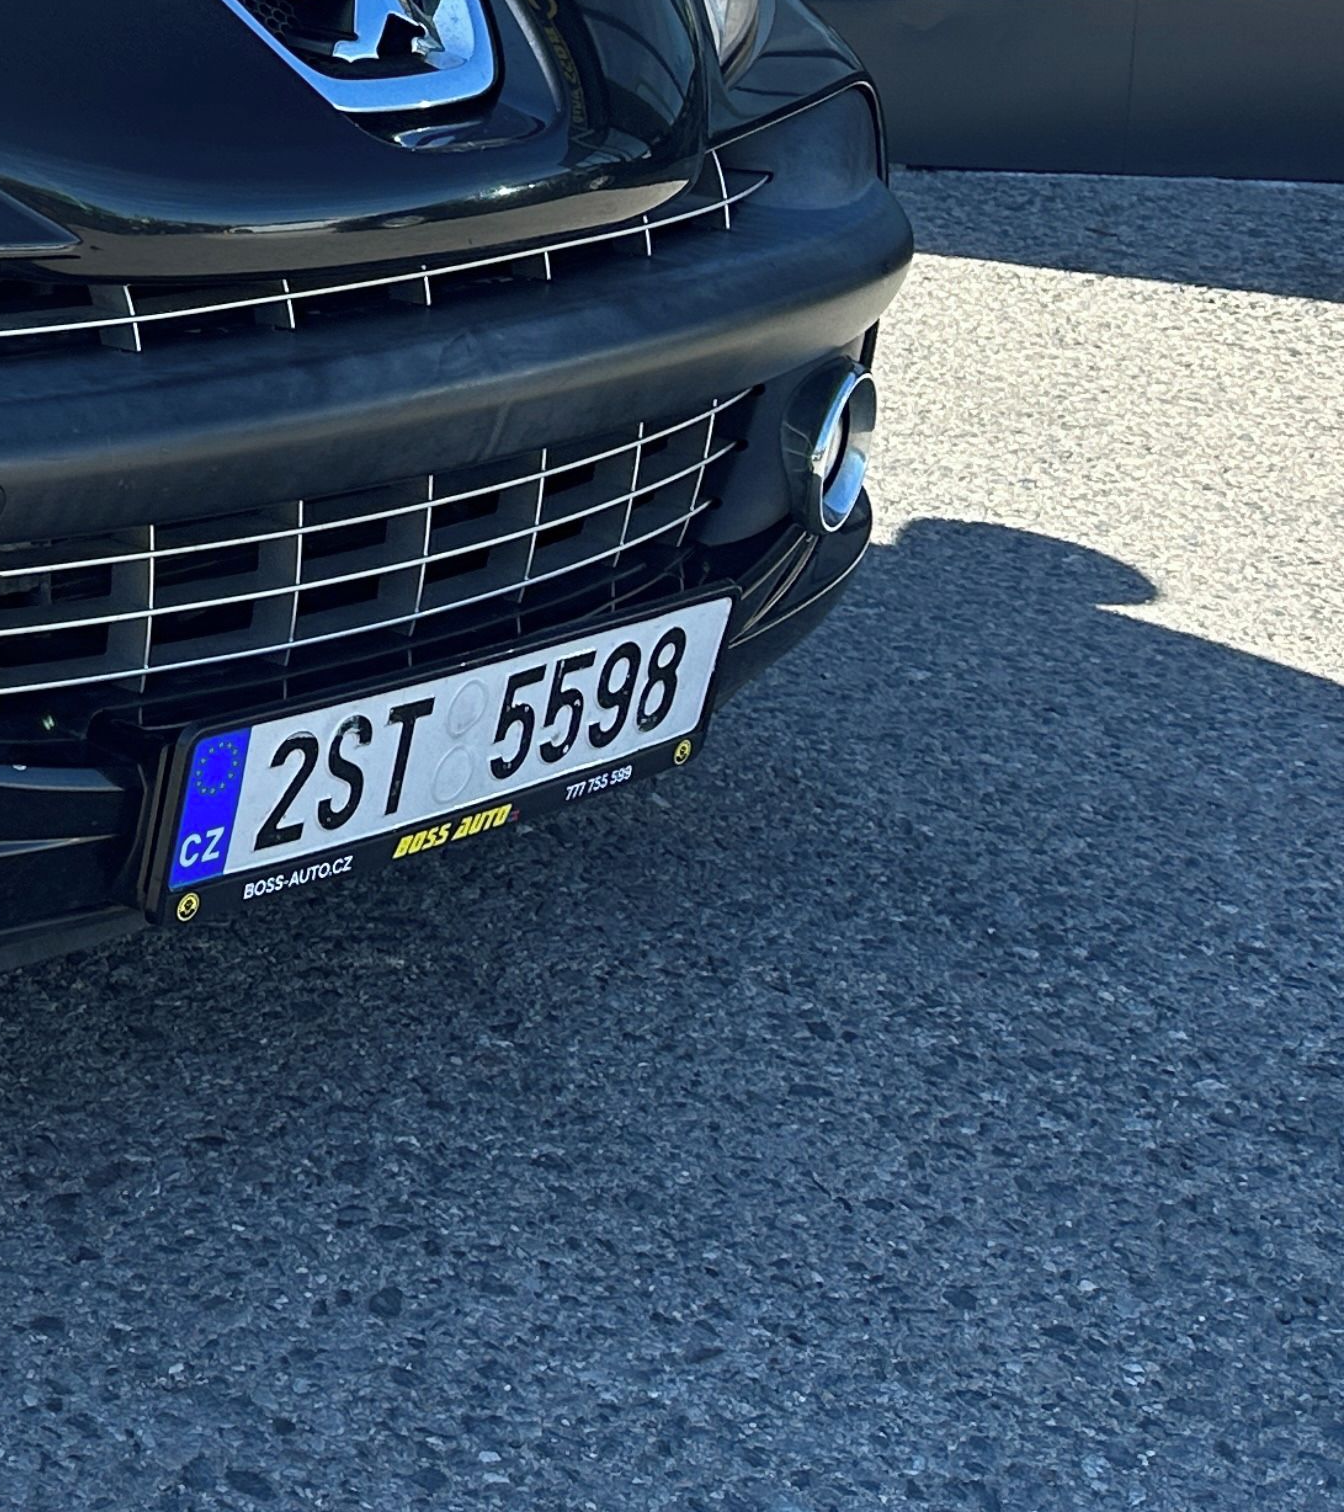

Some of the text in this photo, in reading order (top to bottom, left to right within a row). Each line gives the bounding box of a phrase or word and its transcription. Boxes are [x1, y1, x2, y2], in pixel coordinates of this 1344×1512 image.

[253, 625, 688, 852] 2ST 5598
[565, 781, 587, 801] 777
[179, 826, 225, 868] CZ
[392, 803, 512, 860] BOSS AUTO
[243, 855, 353, 900] BOSS-AUTO.CZ
